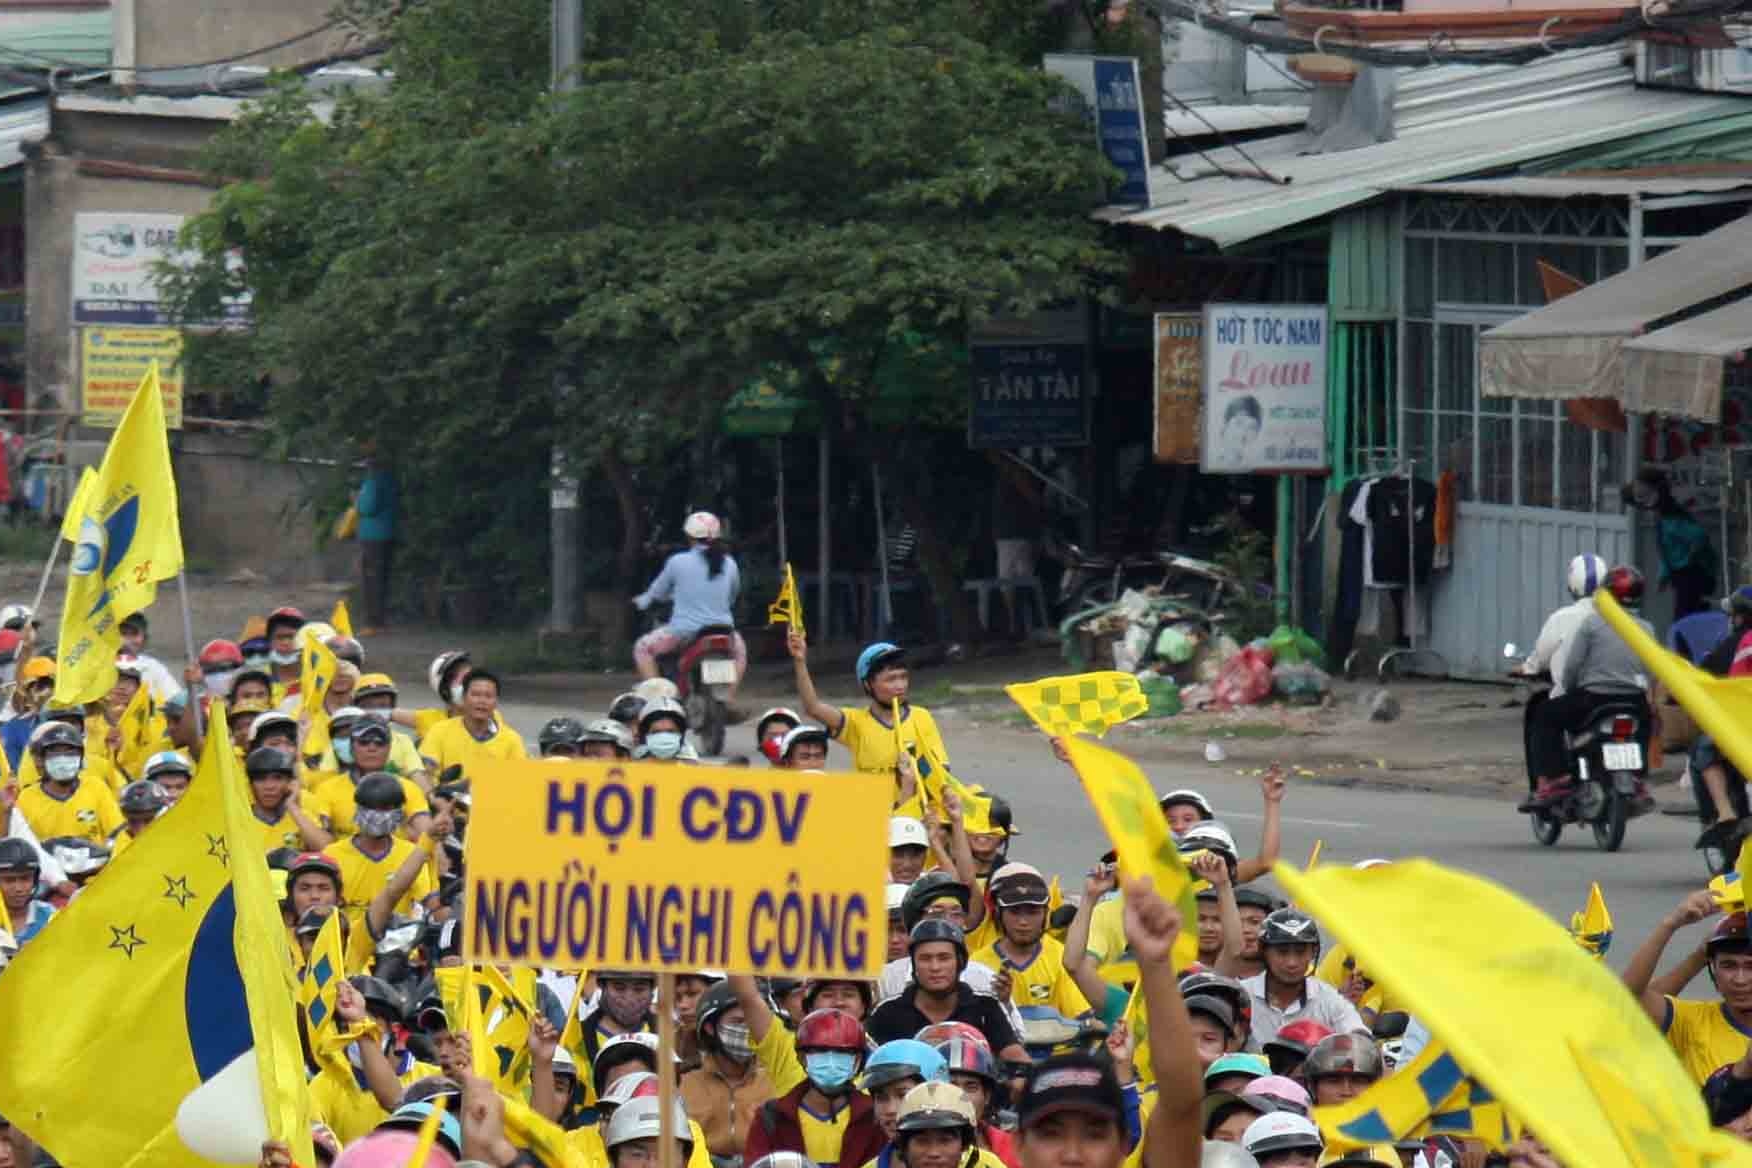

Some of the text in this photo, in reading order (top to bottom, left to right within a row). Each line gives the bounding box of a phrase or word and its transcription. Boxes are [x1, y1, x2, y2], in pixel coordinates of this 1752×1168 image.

[1286, 317, 1322, 345] NAM
[545, 766, 811, 855] HỘI CĐV
[473, 858, 871, 973] NGƯỜI NGHI CÔNG
